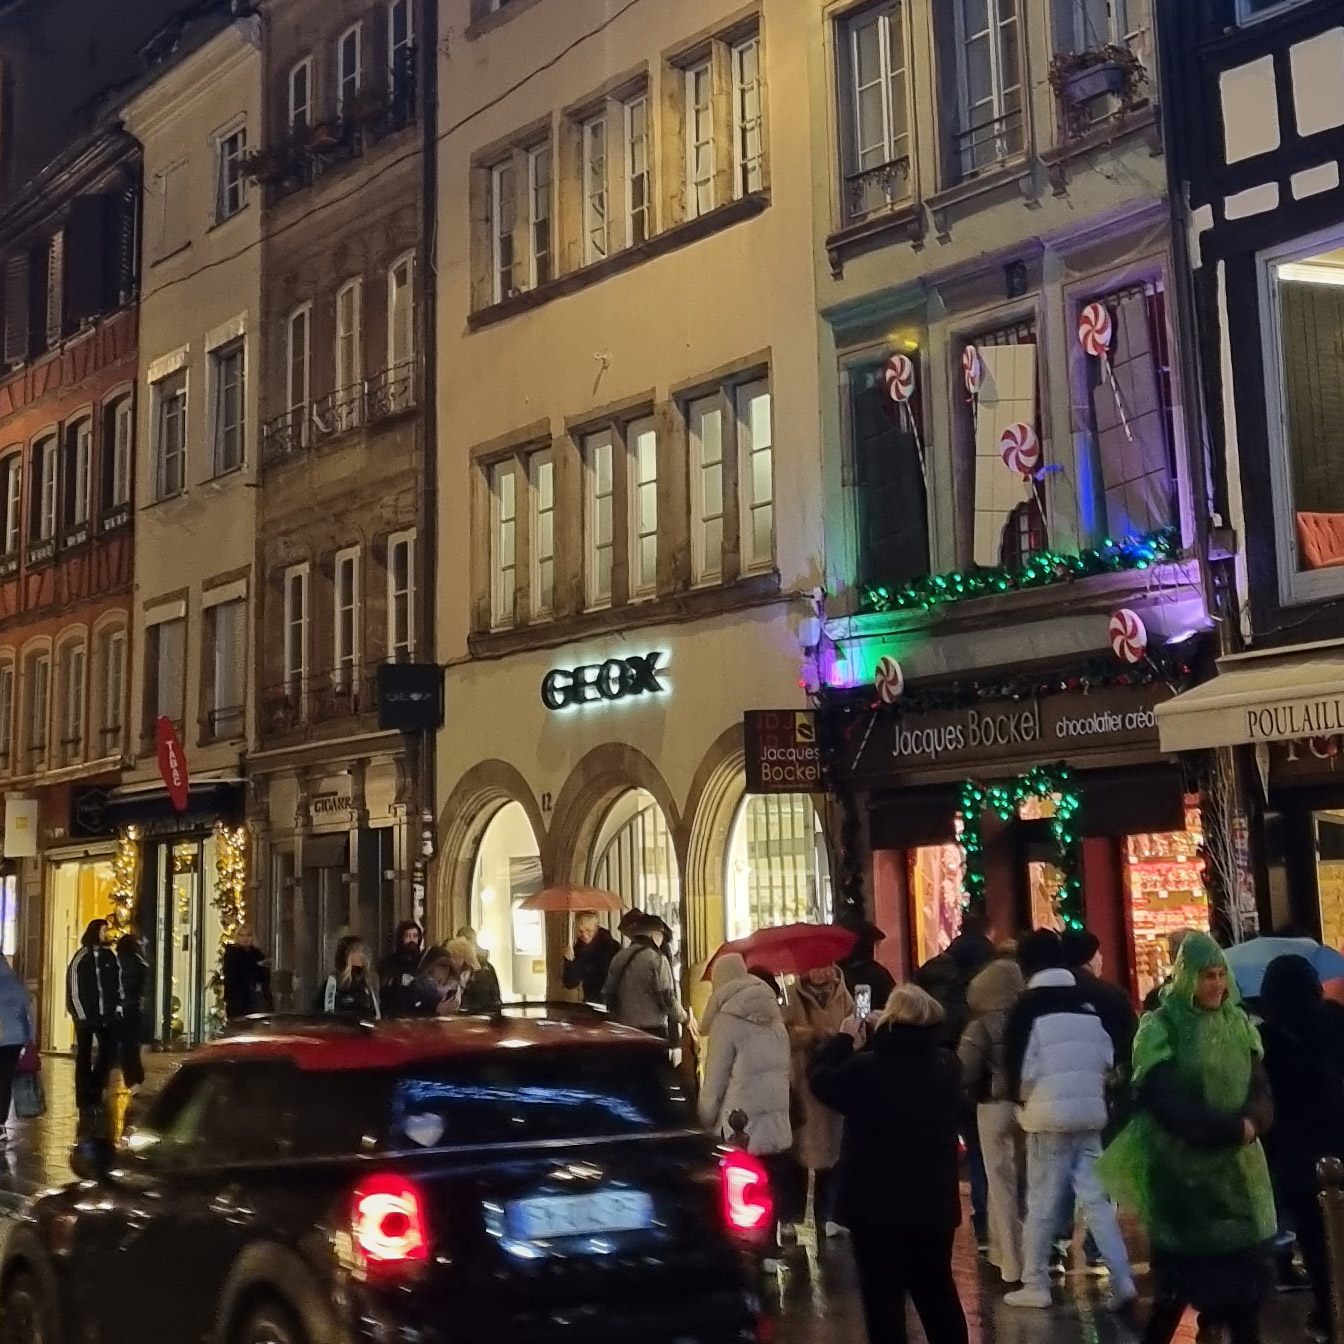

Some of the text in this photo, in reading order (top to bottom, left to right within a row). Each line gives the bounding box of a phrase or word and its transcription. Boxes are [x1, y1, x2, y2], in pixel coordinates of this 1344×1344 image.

[541, 652, 664, 710] GEOX
[893, 723, 964, 759] Jacques
[968, 700, 1040, 747] Bockel
[1056, 711, 1122, 737] chocolatier
[166, 740, 182, 787] TABAC
[761, 746, 820, 763] Jacques
[761, 761, 821, 781] Bockel
[541, 792, 552, 812] 12
